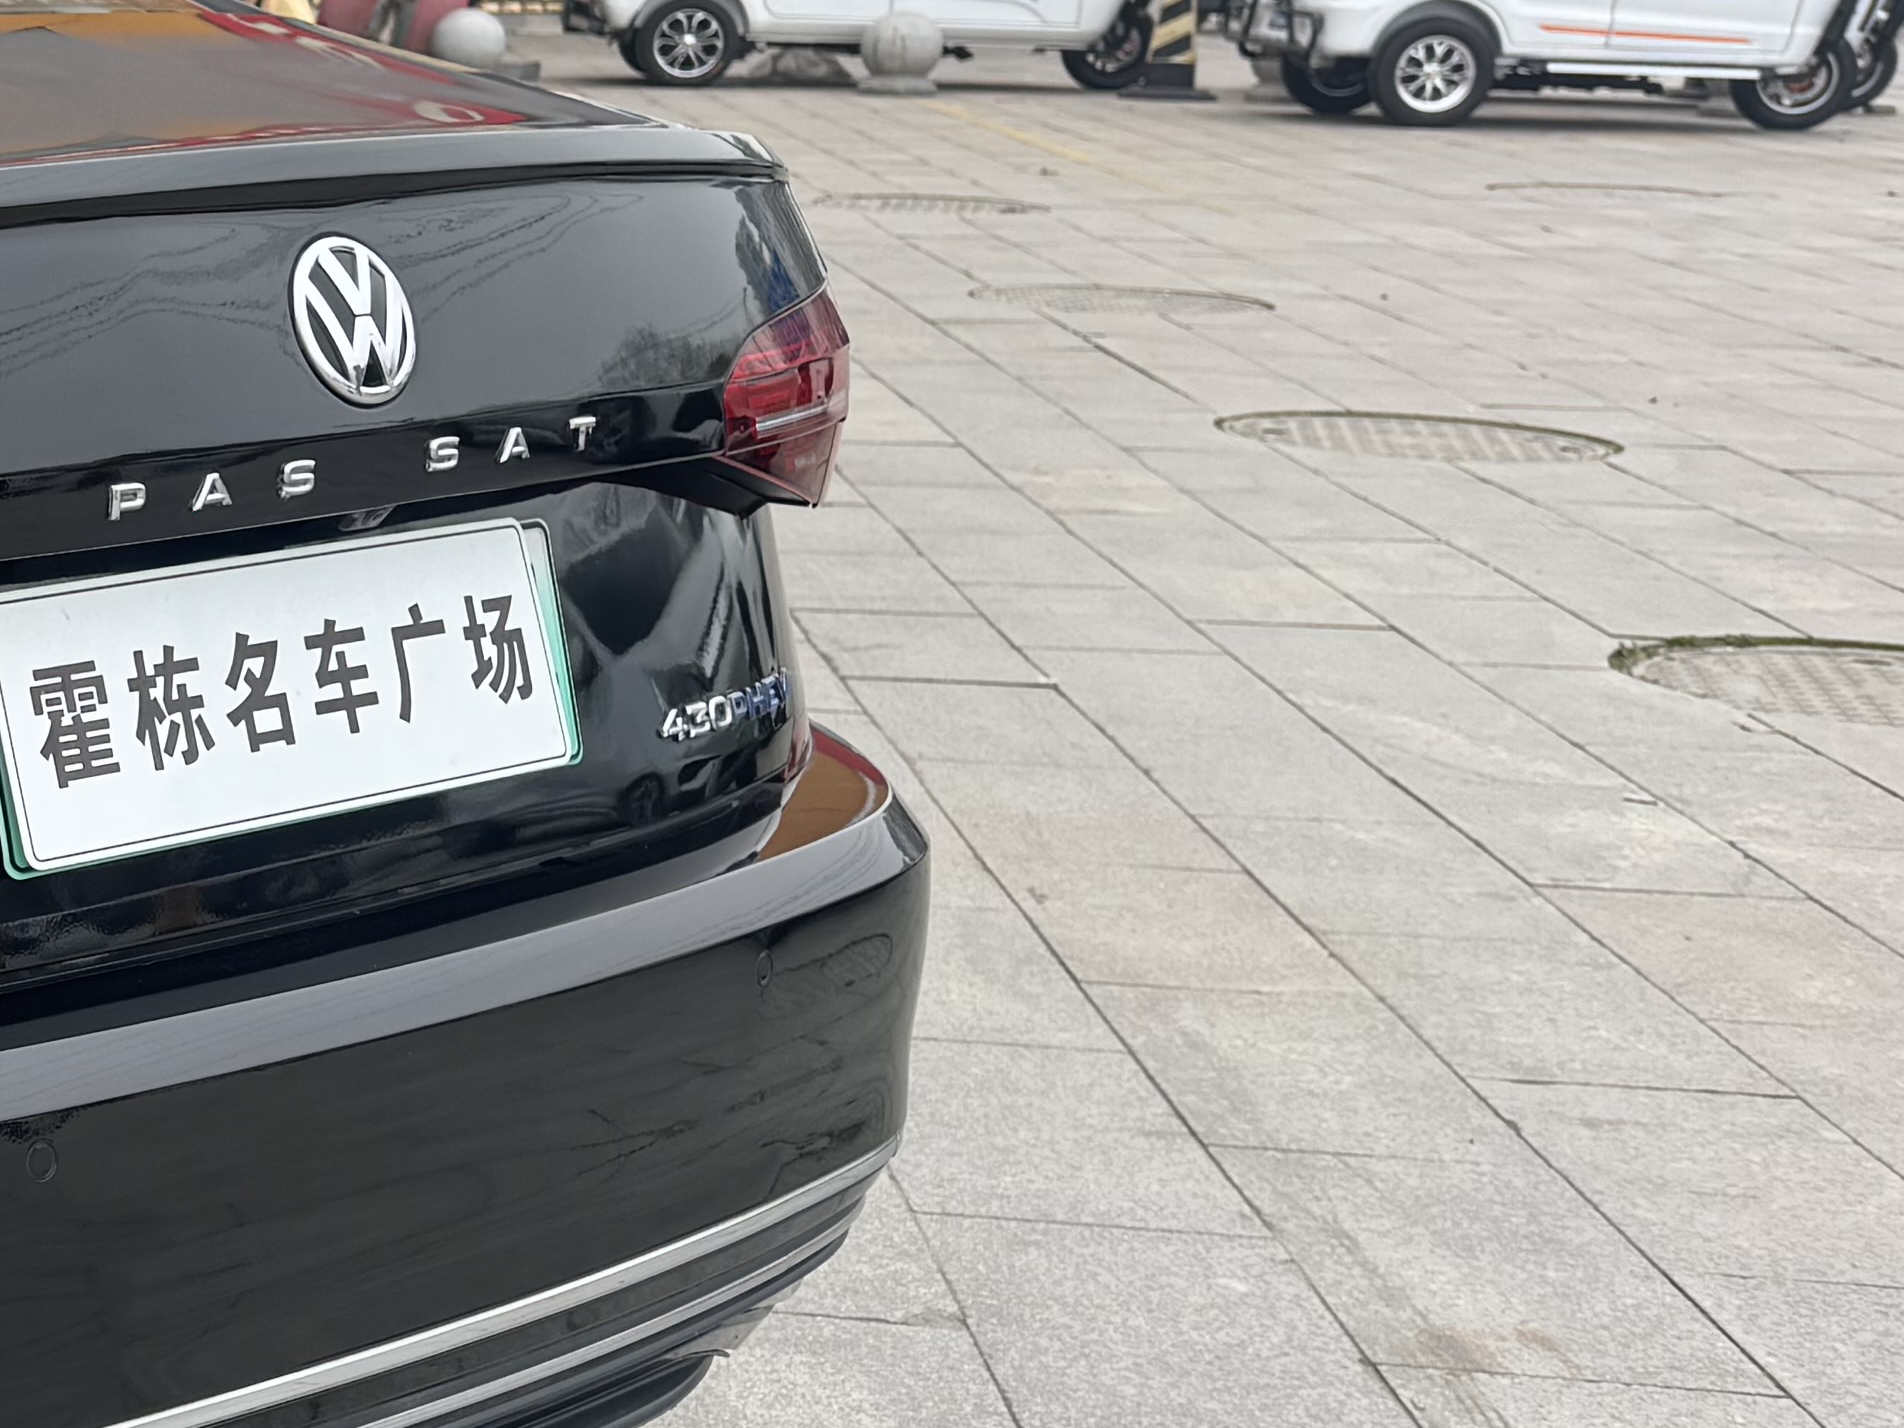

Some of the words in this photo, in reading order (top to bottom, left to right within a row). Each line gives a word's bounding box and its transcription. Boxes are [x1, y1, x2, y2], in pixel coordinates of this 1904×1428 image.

[29, 594, 534, 789] 霍栋名车广场
